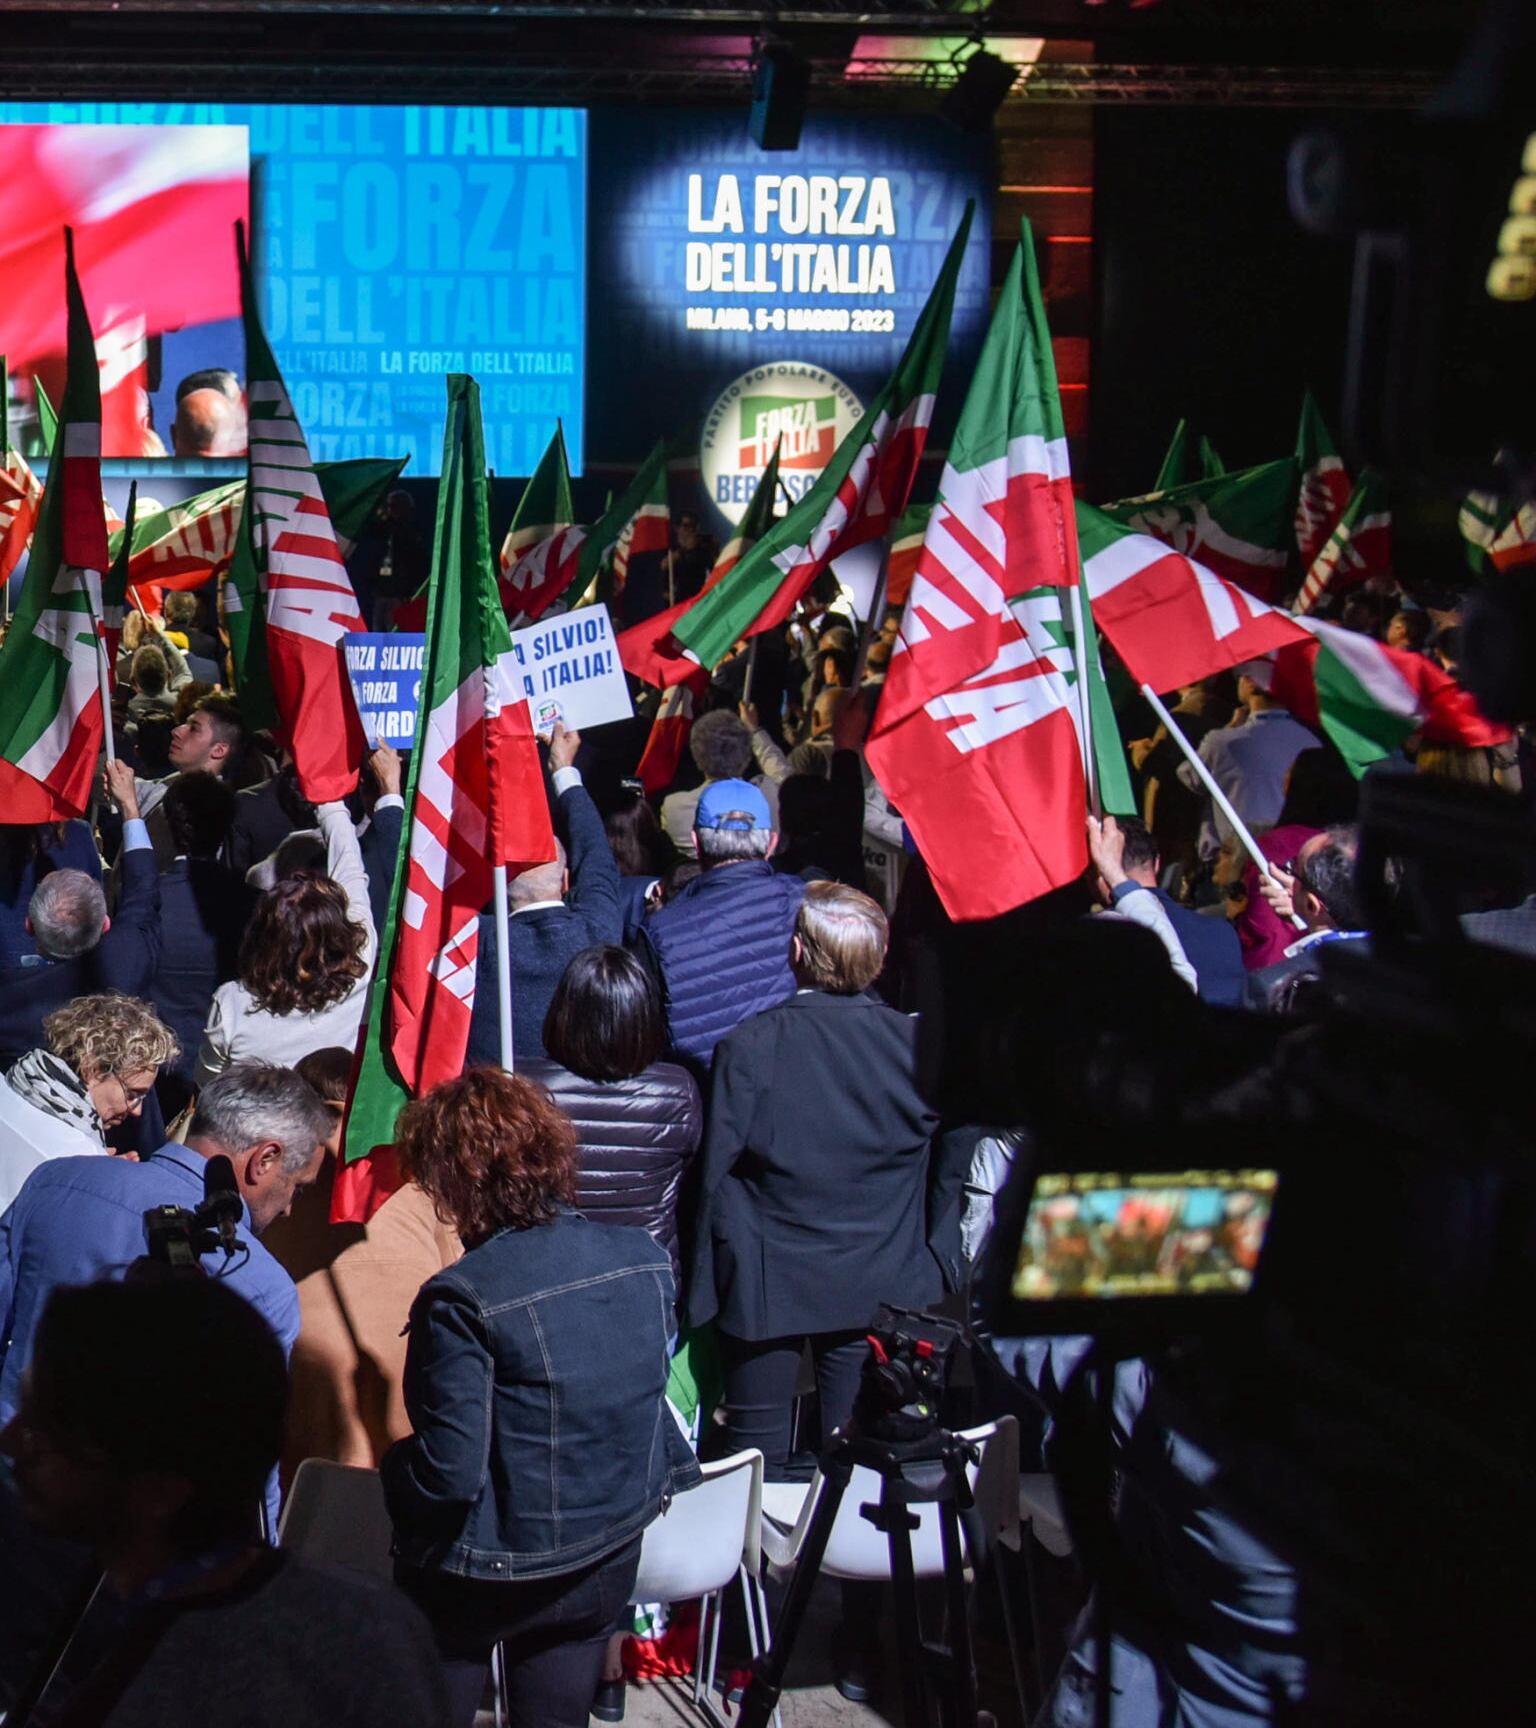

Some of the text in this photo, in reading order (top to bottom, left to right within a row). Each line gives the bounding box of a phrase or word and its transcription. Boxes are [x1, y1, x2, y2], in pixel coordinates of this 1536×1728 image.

[291, 161, 574, 272] FORZA
[688, 174, 744, 233] LA
[754, 175, 896, 235] FORZA
[685, 243, 896, 294] DELL'ITALIA
[686, 308, 895, 332] MILANO, 5-6 MAGGIO 2023
[278, 351, 574, 375] ELL'ITALIA LA FORZA DELL'ITALIA
[744, 365, 828, 386] POPOLARE
[830, 382, 862, 419] EURO
[755, 400, 820, 440] FORZA
[533, 616, 606, 661] SILVIO!
[362, 682, 397, 703] FORZA
[542, 649, 613, 693] ITALIA!
